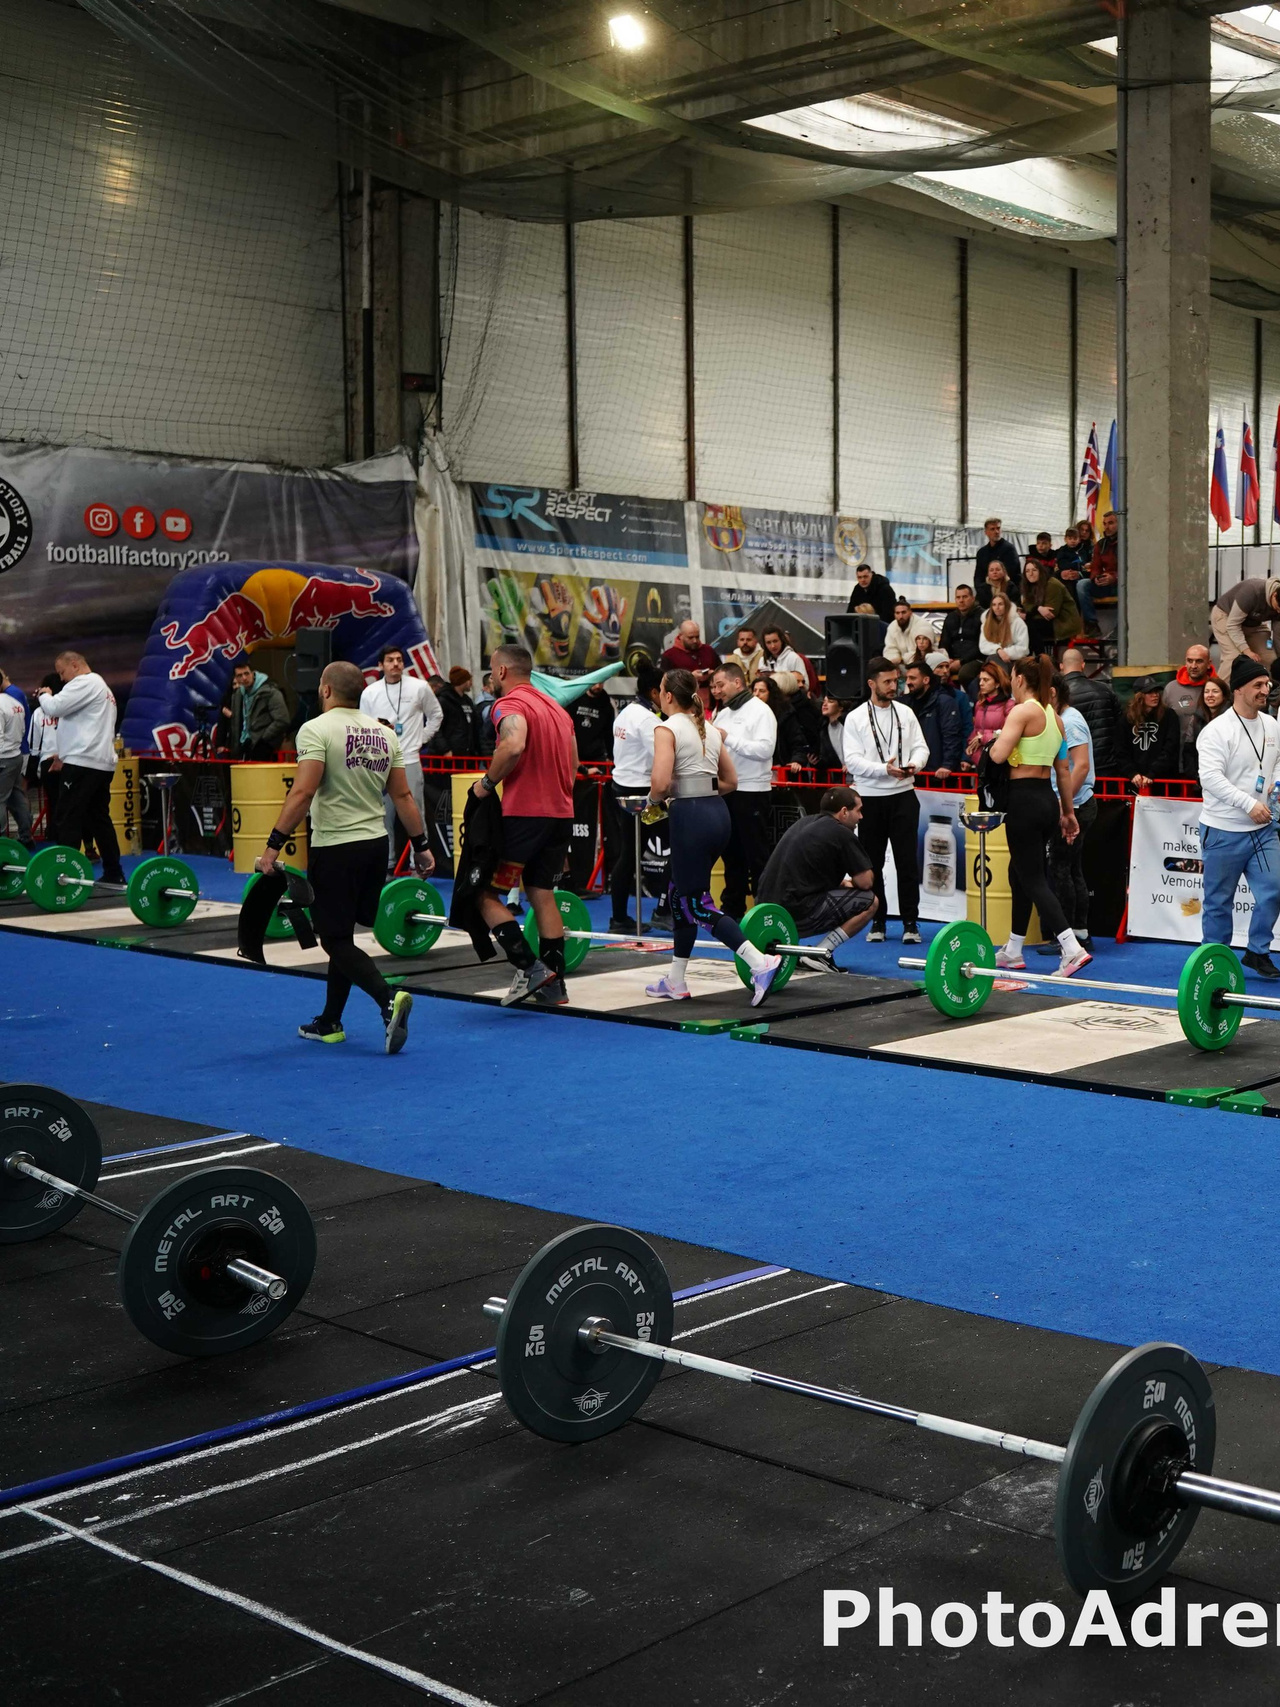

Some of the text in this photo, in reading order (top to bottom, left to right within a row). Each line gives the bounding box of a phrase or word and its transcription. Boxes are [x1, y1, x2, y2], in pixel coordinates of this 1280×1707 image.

[546, 489, 598, 507] SPORT
[545, 502, 613, 523] RESPECT
[516, 542, 648, 563] www.SportRespect.com
[1163, 840, 1198, 854] makes
[973, 854, 993, 889] 6
[1151, 893, 1173, 904] you
[942, 980, 963, 1003] METAL
[1193, 976, 1213, 1034] METAL ART
[4, 1106, 43, 1120] ART
[154, 1194, 254, 1273] METAL ART
[545, 1256, 646, 1305] METAL ART
[157, 1290, 176, 1308] 5
[163, 1297, 186, 1320] KG
[636, 1311, 655, 1326] KG
[528, 1324, 544, 1342] 5
[525, 1341, 546, 1358] KG
[1143, 1379, 1156, 1409] KG
